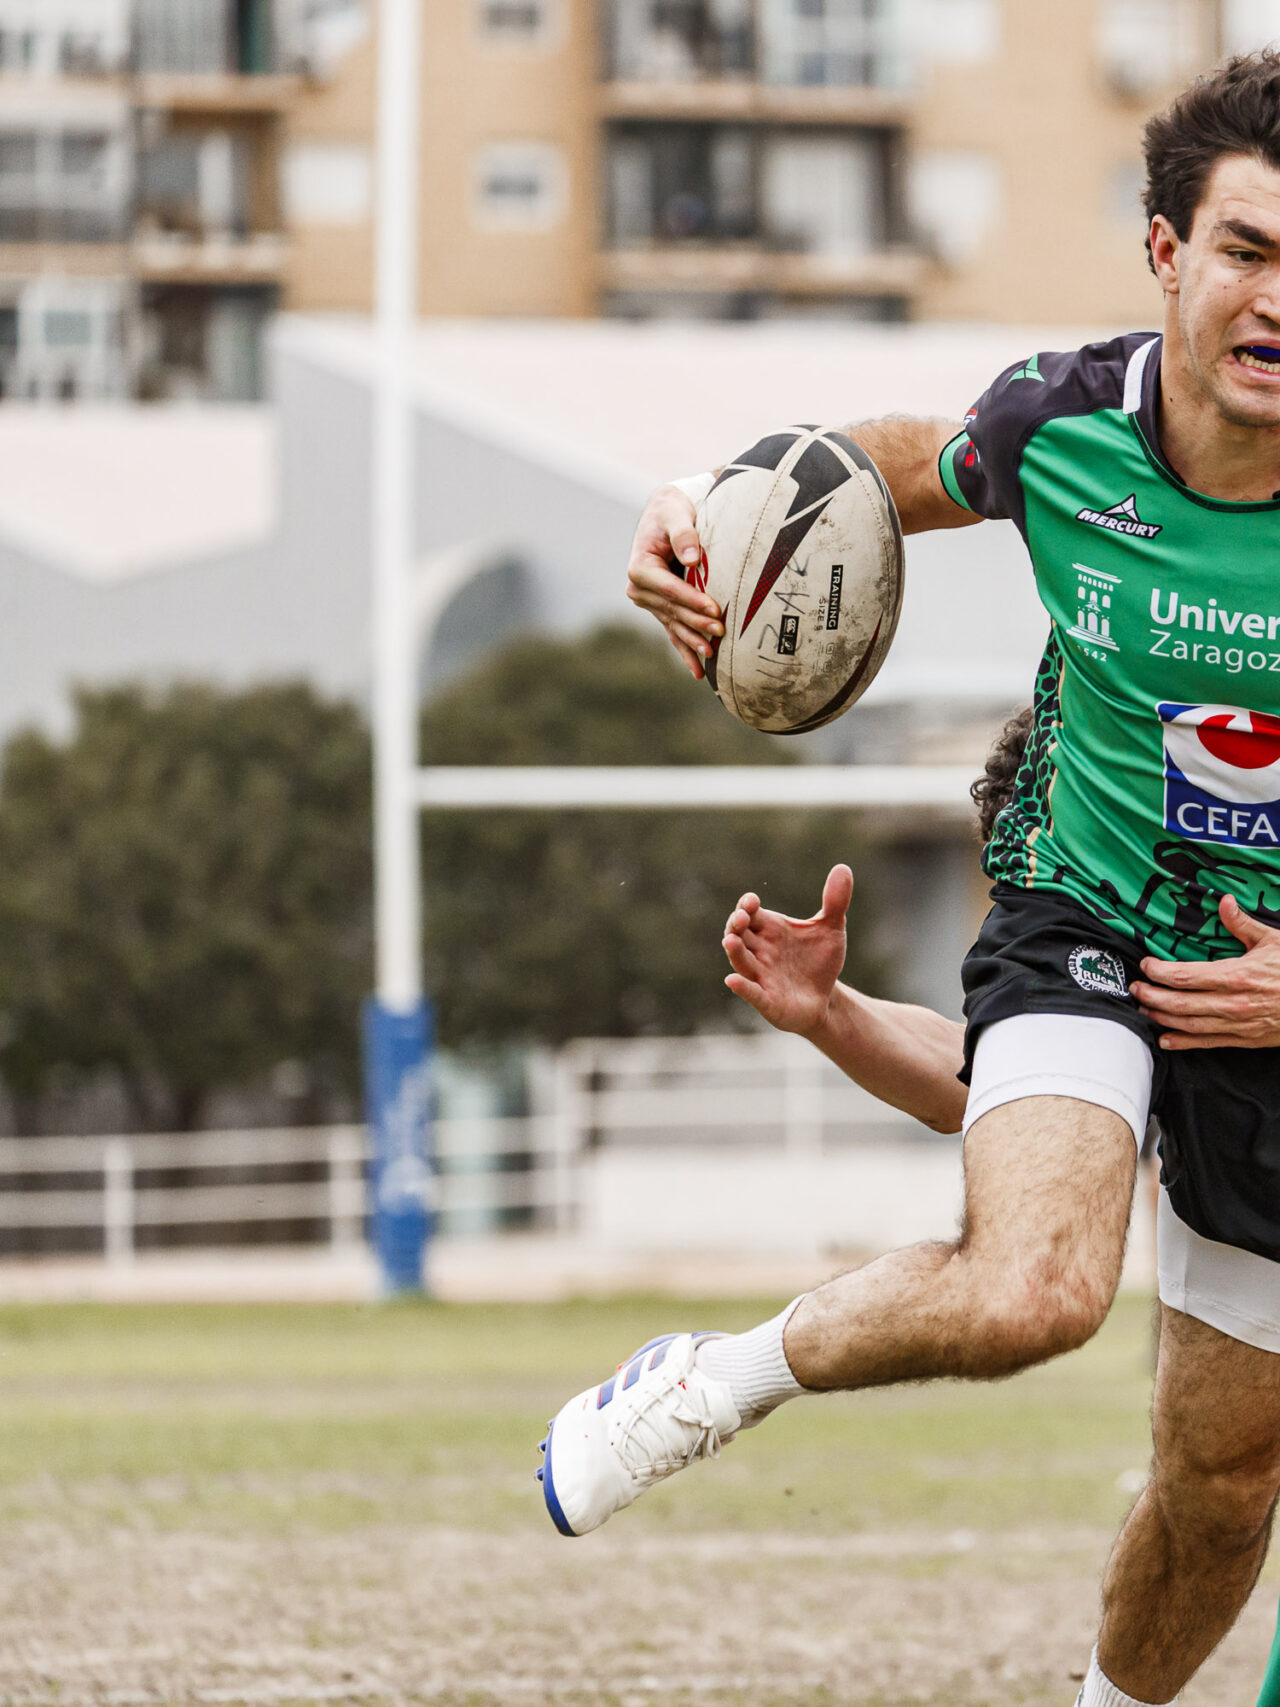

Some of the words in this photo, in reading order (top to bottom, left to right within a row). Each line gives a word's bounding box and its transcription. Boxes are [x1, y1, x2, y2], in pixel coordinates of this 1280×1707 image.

[1077, 510, 1160, 537] MERCURY
[817, 598, 826, 622] SIZE
[827, 567, 842, 629] TRAINING
[1176, 802, 1279, 842] CEFA
